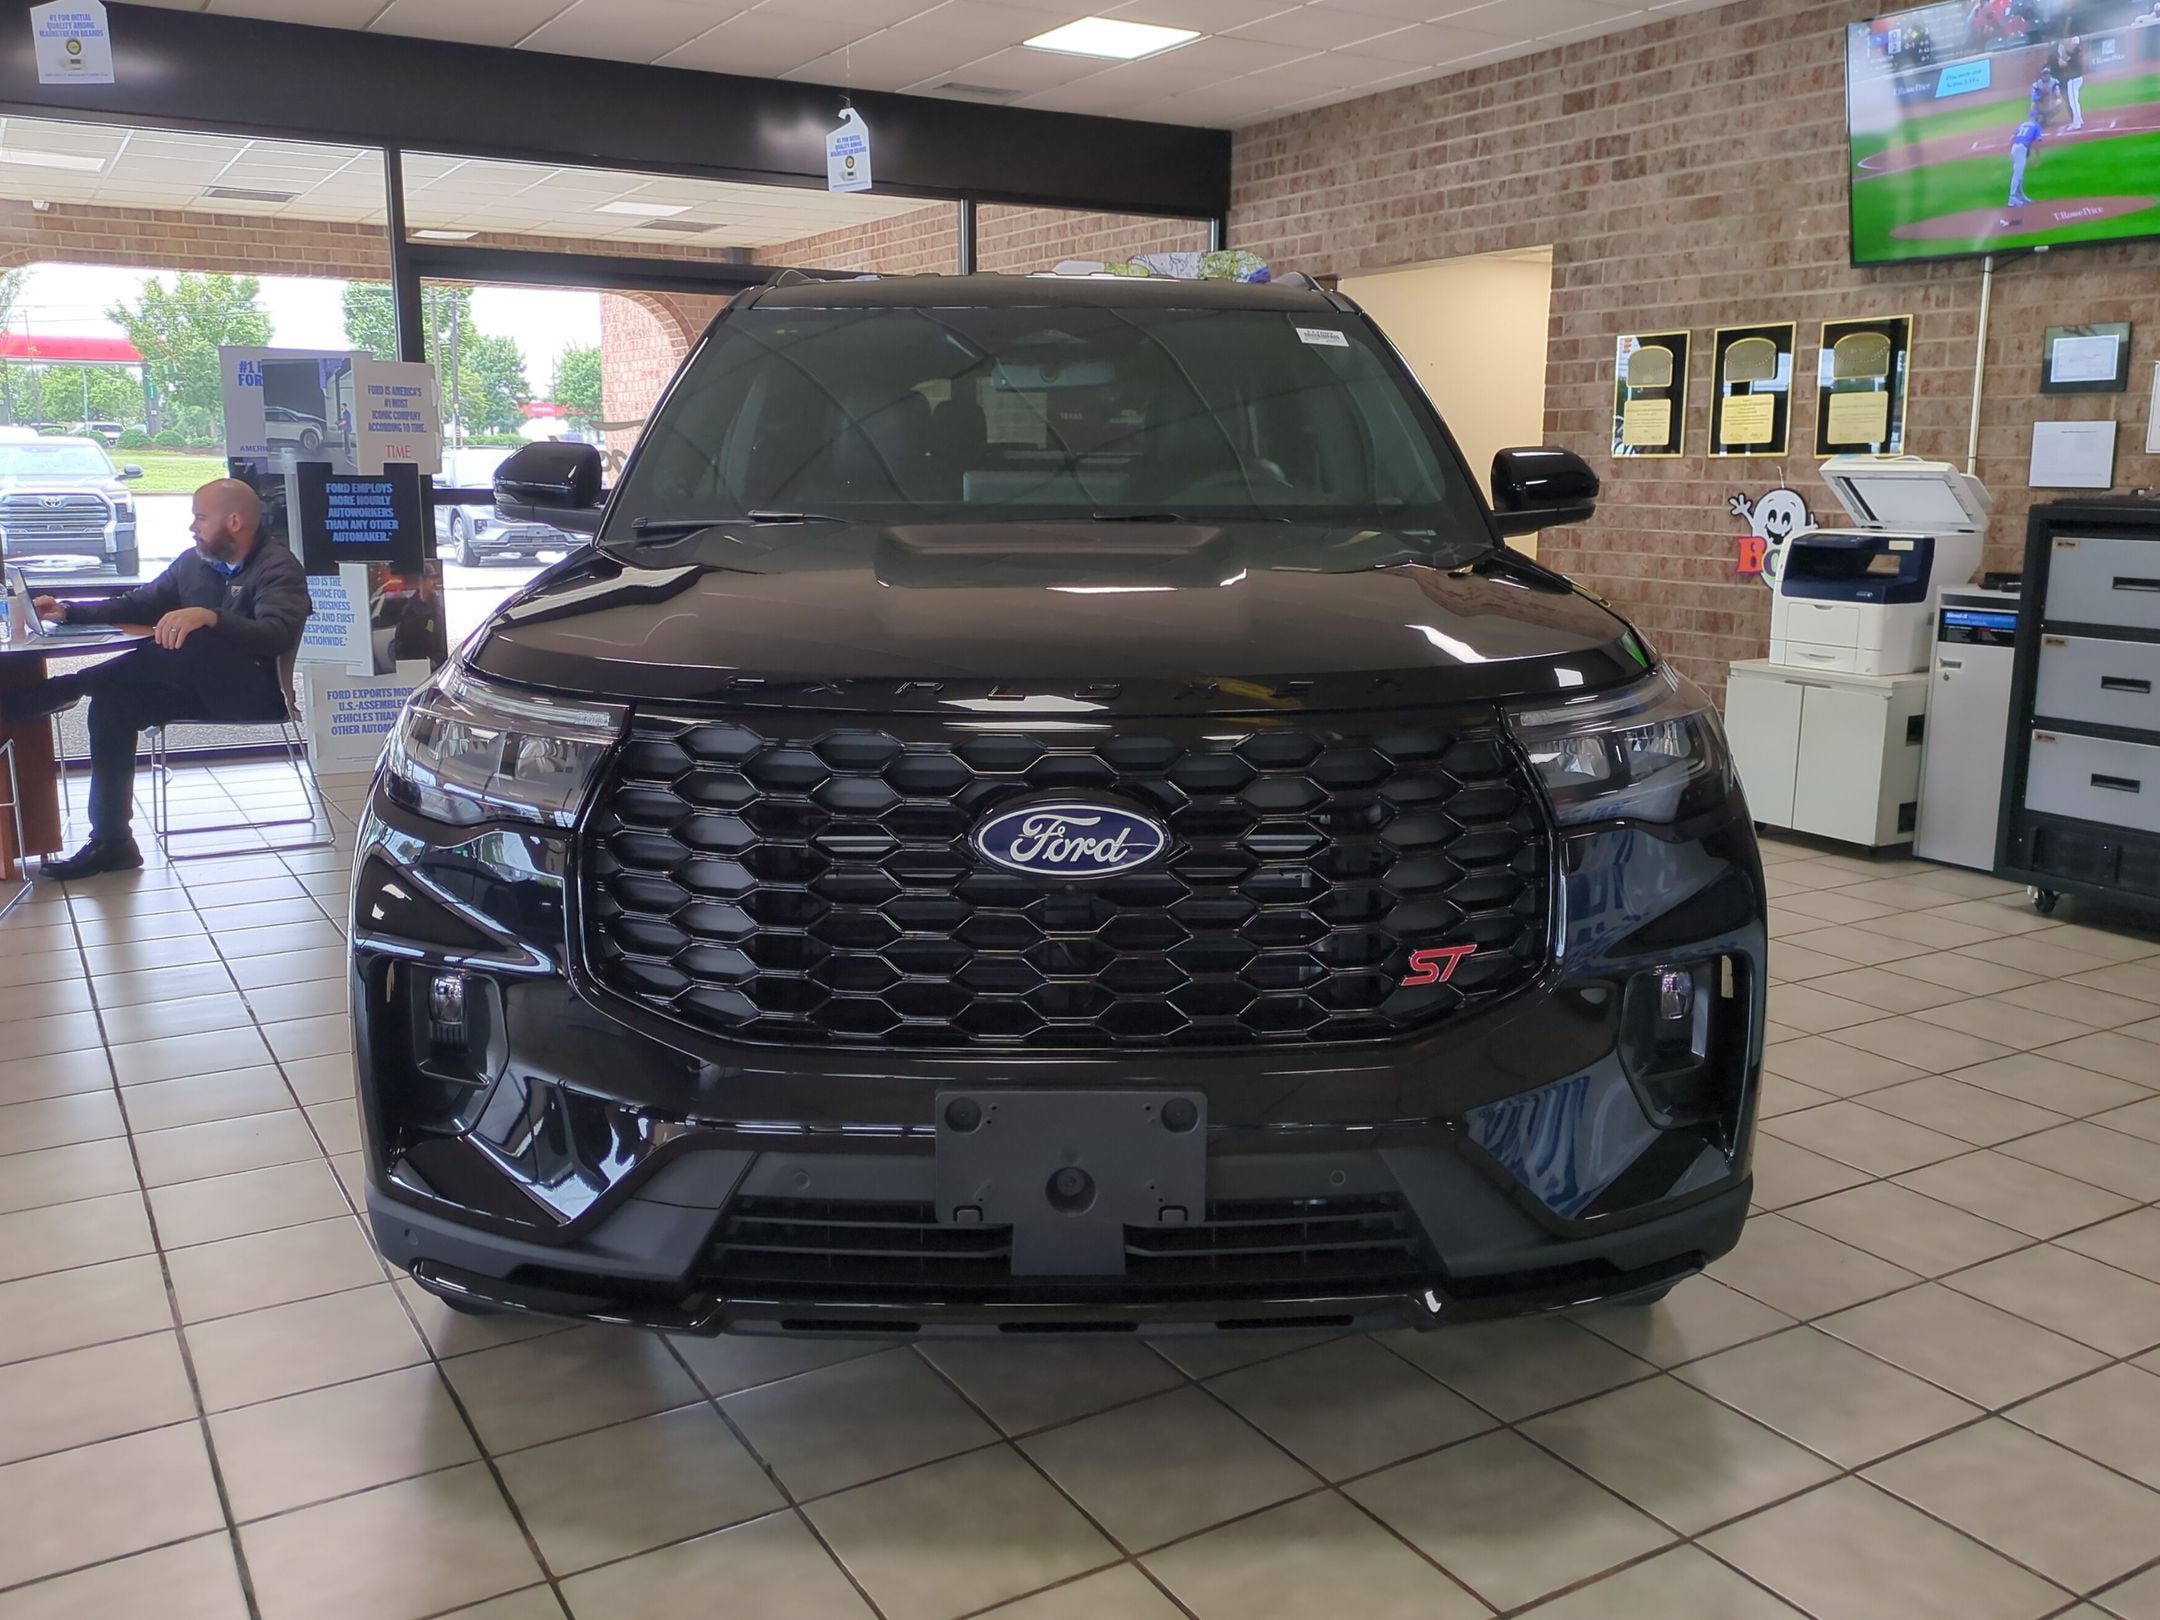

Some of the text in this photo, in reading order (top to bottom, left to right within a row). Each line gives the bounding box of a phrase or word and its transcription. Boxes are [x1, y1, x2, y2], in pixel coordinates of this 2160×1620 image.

[58, 13, 70, 21] FOR
[47, 21, 95, 30] QUALITY AMONG
[80, 29, 104, 37] BRANDS
[239, 361, 254, 373] #1
[368, 385, 422, 397] FORD IS AMERICA'S
[392, 399, 408, 408] MOST
[372, 410, 420, 421] ICONIC COMPANY
[368, 422, 402, 432] ACCORDING
[403, 423, 410, 432] TO
[385, 445, 411, 458] TIME
[326, 483, 393, 493] FORD EMPLOYS
[329, 495, 391, 505] MORE HOURLY
[328, 508, 394, 517] AUTOWORKERS
[325, 520, 399, 529] THAN ANY OTHER
[321, 577, 328, 586] IS
[329, 577, 342, 586] THE
[309, 589, 347, 599] CHOICE FOR
[319, 601, 351, 610] BUSINESS
[321, 614, 336, 622] AND
[337, 614, 355, 623] FIRST
[304, 624, 347, 634] RESPONDERS
[327, 687, 417, 700] FORD EXPORTS MOR
[332, 711, 398, 723] VEHICLES THAN
[331, 725, 360, 736] OTHER
[1010, 814, 1157, 862] Ford
[1399, 944, 1477, 987] ST
